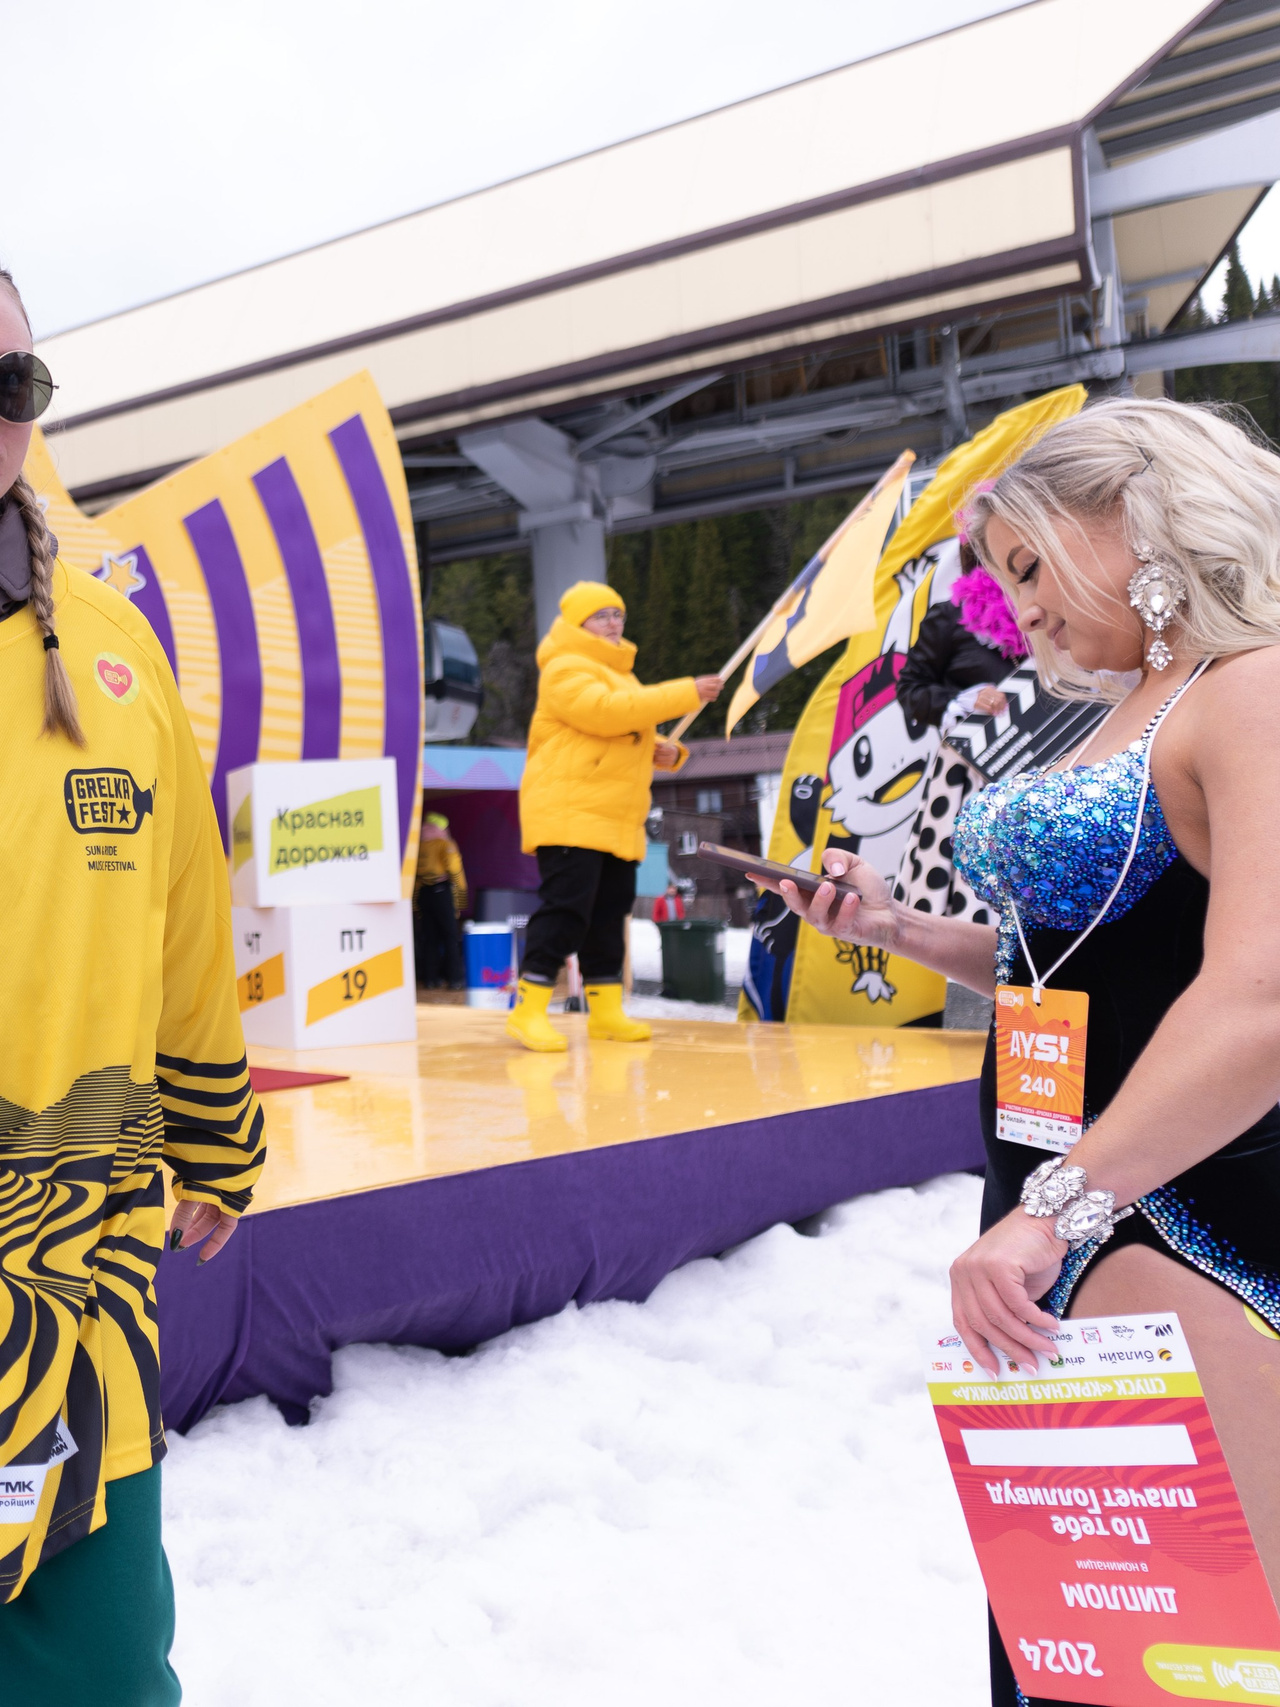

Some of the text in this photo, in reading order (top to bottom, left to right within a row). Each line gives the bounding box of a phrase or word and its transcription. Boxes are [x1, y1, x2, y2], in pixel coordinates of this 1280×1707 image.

[75, 777, 130, 800] GRELKA
[78, 801, 117, 825] FEST
[277, 808, 365, 835] Красная
[85, 845, 101, 856] SUN
[275, 844, 370, 869] дорожка
[104, 861, 137, 872] FESTIVAL
[341, 968, 368, 1001] 19
[1010, 1030, 1069, 1065] AYS!
[1020, 1073, 1057, 1098] 240
[1099, 1350, 1155, 1365] билайн
[952, 1376, 1167, 1402] СПУСК «КРАСНАЯ ДОРОЖКА»
[985, 1478, 1197, 1514] плачет Голливуд
[1050, 1515, 1151, 1544] По тебе
[1075, 1559, 1149, 1572] в номинации
[1060, 1581, 1178, 1613] ДИПЛОМ
[1018, 1637, 1104, 1677] 2024
